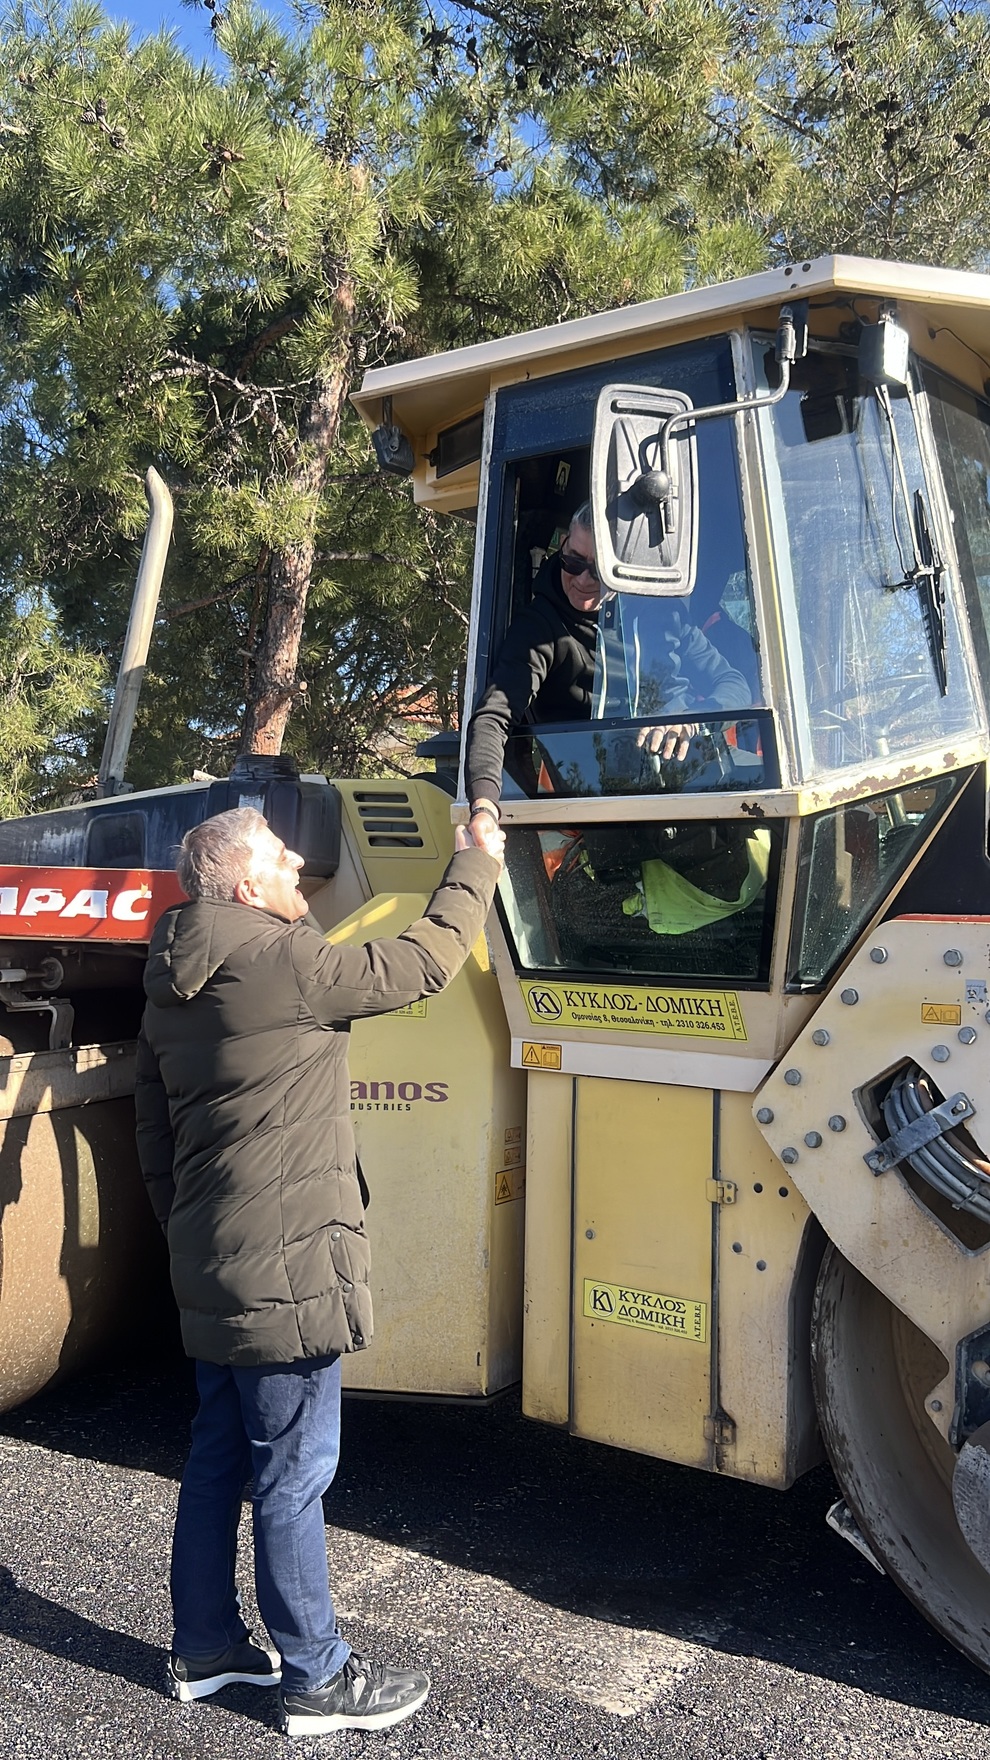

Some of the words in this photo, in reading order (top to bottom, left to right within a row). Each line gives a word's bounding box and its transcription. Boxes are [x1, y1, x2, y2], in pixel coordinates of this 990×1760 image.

[646, 995, 724, 1017] ΔΟΜΙΚΗ
[676, 1019, 695, 1030] 2310
[696, 1021, 726, 1031] 326.453
[618, 1289, 687, 1314] ΚΥΚΛΟΣ
[618, 1304, 686, 1329] ΔΟΜΙΚΗ
